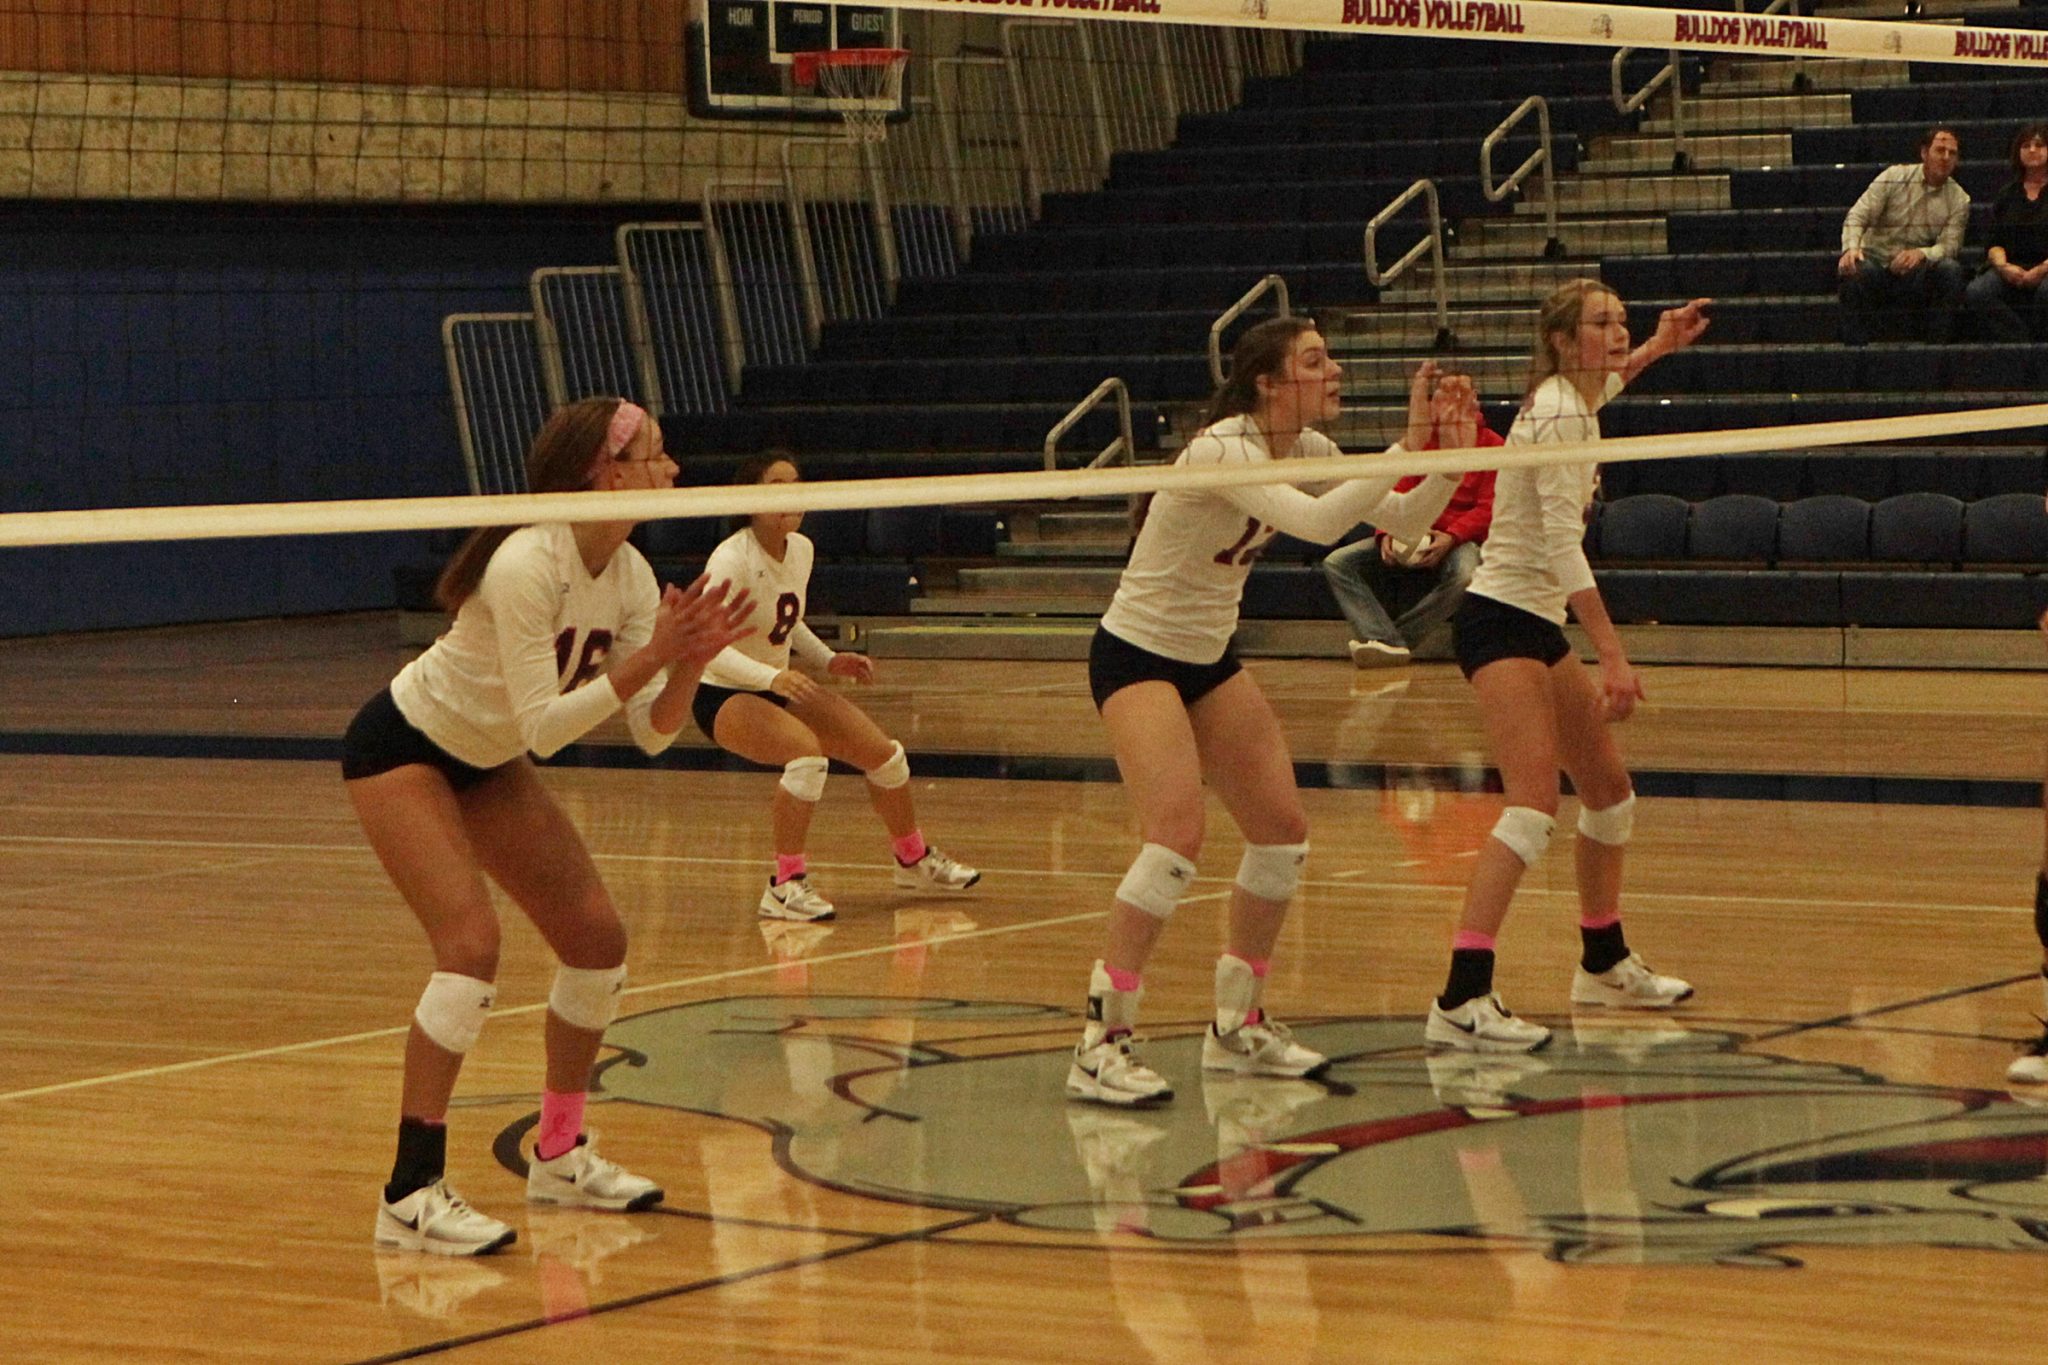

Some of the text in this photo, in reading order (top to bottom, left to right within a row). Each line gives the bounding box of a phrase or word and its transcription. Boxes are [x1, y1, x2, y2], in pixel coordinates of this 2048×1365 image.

[851, 12, 885, 32] GUEST
[1342, 0, 1525, 34] BULLDOG VOLLEYBALL
[1675, 14, 1828, 50] BULLDOG VOLLEYBALL
[1953, 31, 2010, 58] BULLDOG
[768, 592, 799, 645] 8
